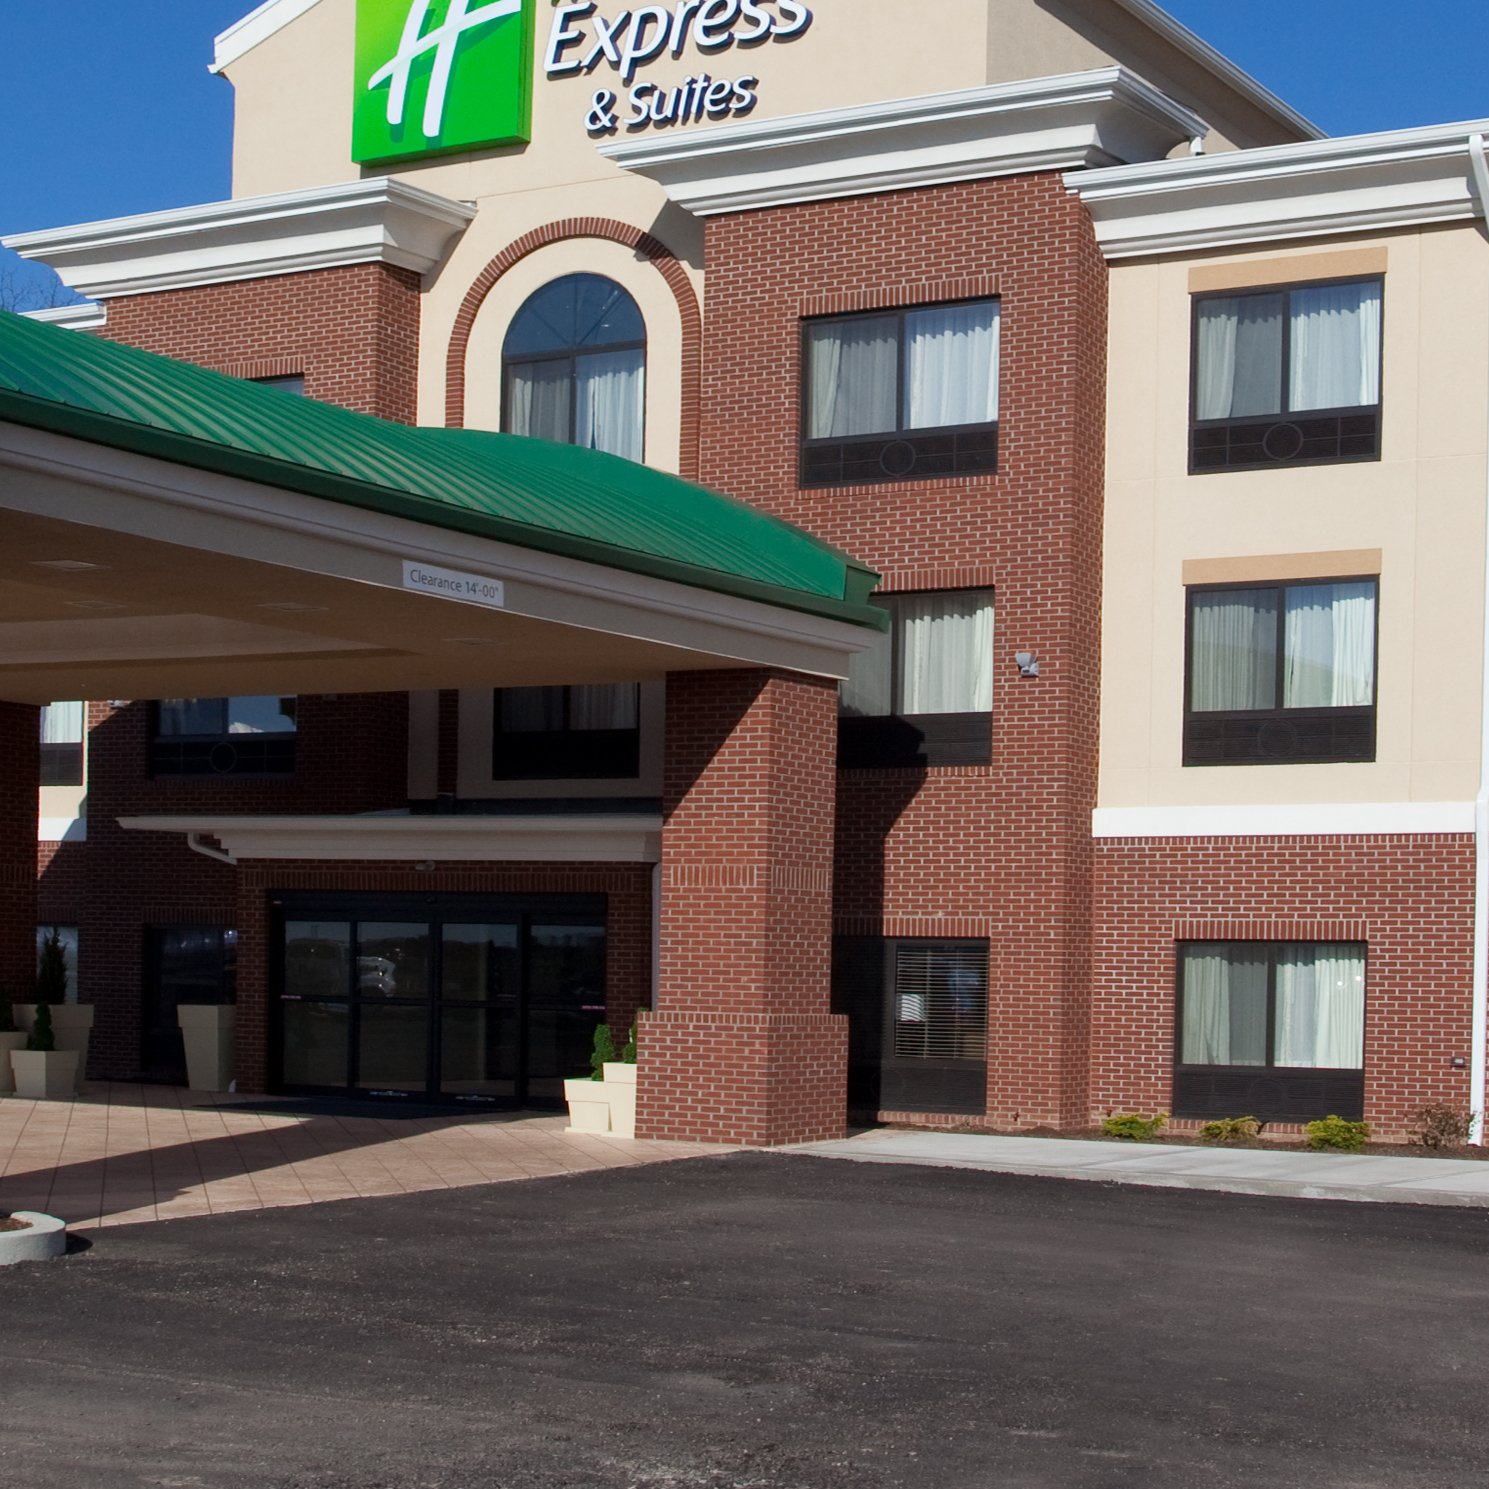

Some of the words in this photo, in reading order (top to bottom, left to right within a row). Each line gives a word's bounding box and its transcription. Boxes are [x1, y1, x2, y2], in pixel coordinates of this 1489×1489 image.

[584, 88, 616, 132] &
[623, 73, 758, 127] Suites
[410, 569, 462, 592] Clearance
